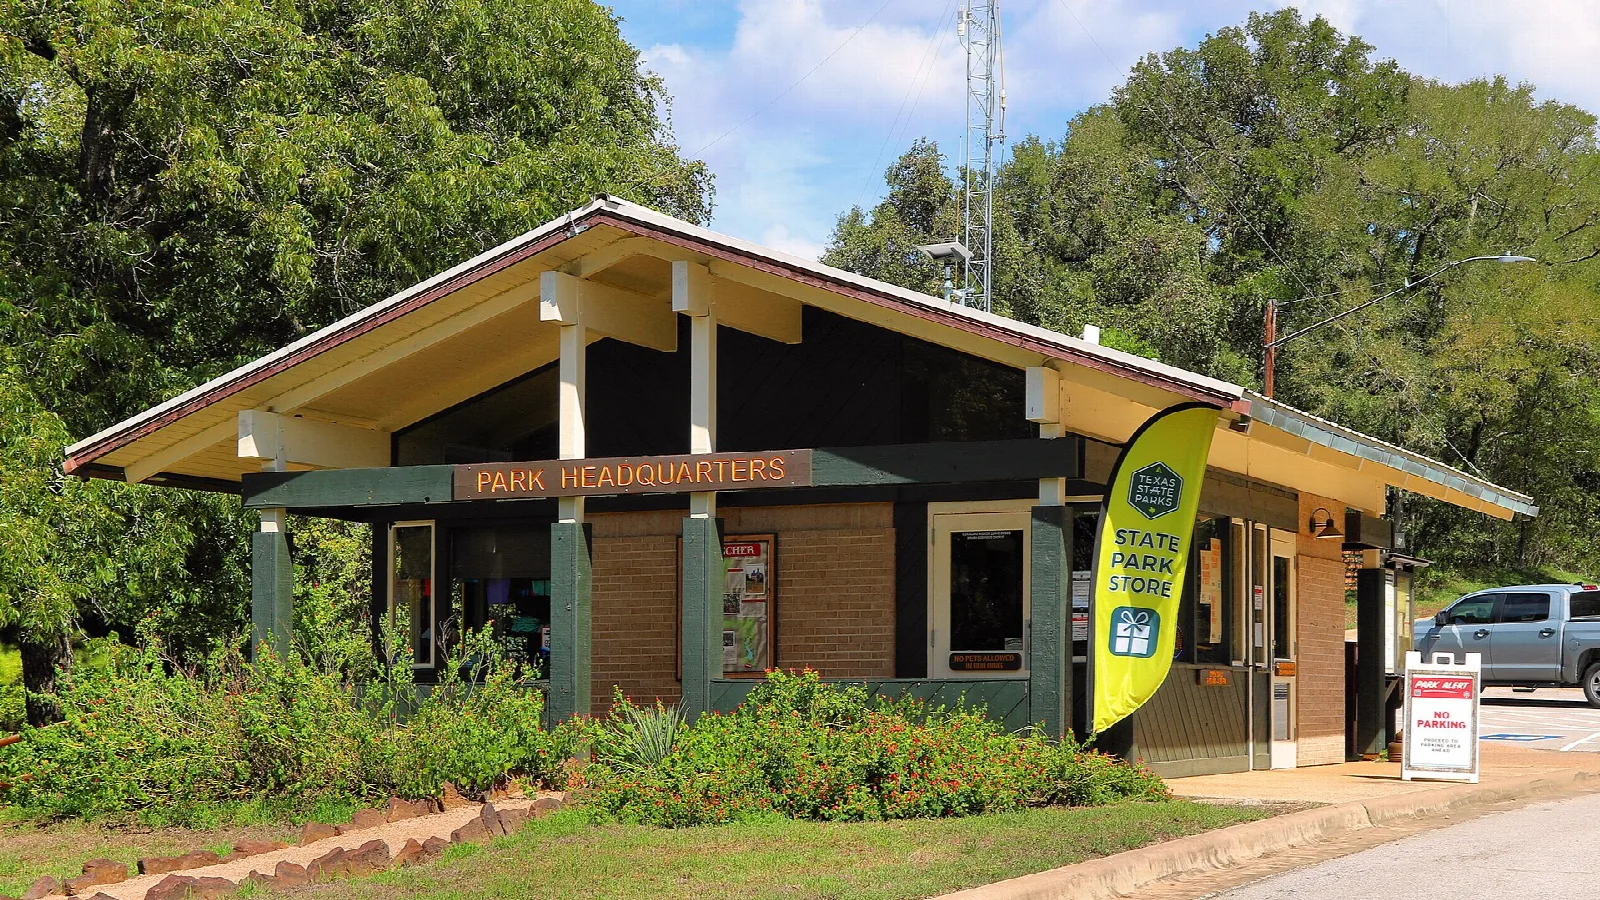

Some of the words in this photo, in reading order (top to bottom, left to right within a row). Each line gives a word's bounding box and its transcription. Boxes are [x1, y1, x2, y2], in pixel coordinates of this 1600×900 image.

[477, 469, 545, 493] PARK
[561, 456, 786, 489] HEADQUARTERS
[1139, 474, 1176, 488] TEXAS
[1136, 484, 1175, 498] STATE
[1134, 494, 1173, 507] PARKS
[1114, 528, 1181, 553] STATE
[724, 545, 755, 555] CHER
[1111, 552, 1175, 575] PARK
[1108, 575, 1173, 598] STORE
[1414, 680, 1440, 689] PARK
[1442, 681, 1470, 689] ALERT
[1434, 711, 1450, 719] NO
[1417, 720, 1466, 729] PARKING
